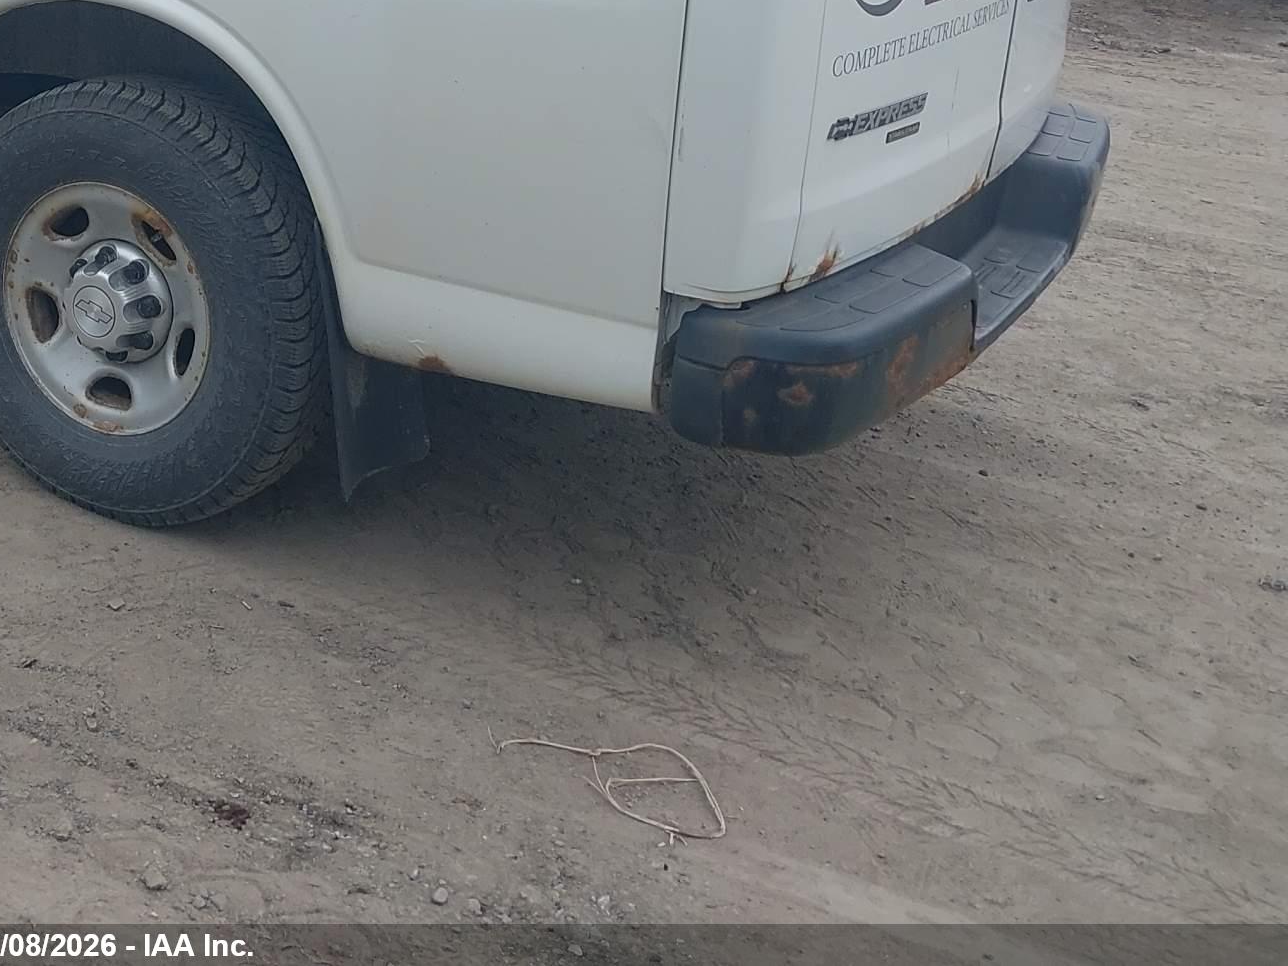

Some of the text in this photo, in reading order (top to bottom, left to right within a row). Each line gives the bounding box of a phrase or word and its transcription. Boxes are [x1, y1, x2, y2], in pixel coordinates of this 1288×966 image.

[832, 36, 906, 77] COMPLETE
[908, 15, 970, 54] ELECTRICAL
[852, 92, 928, 135] EXPRESS
